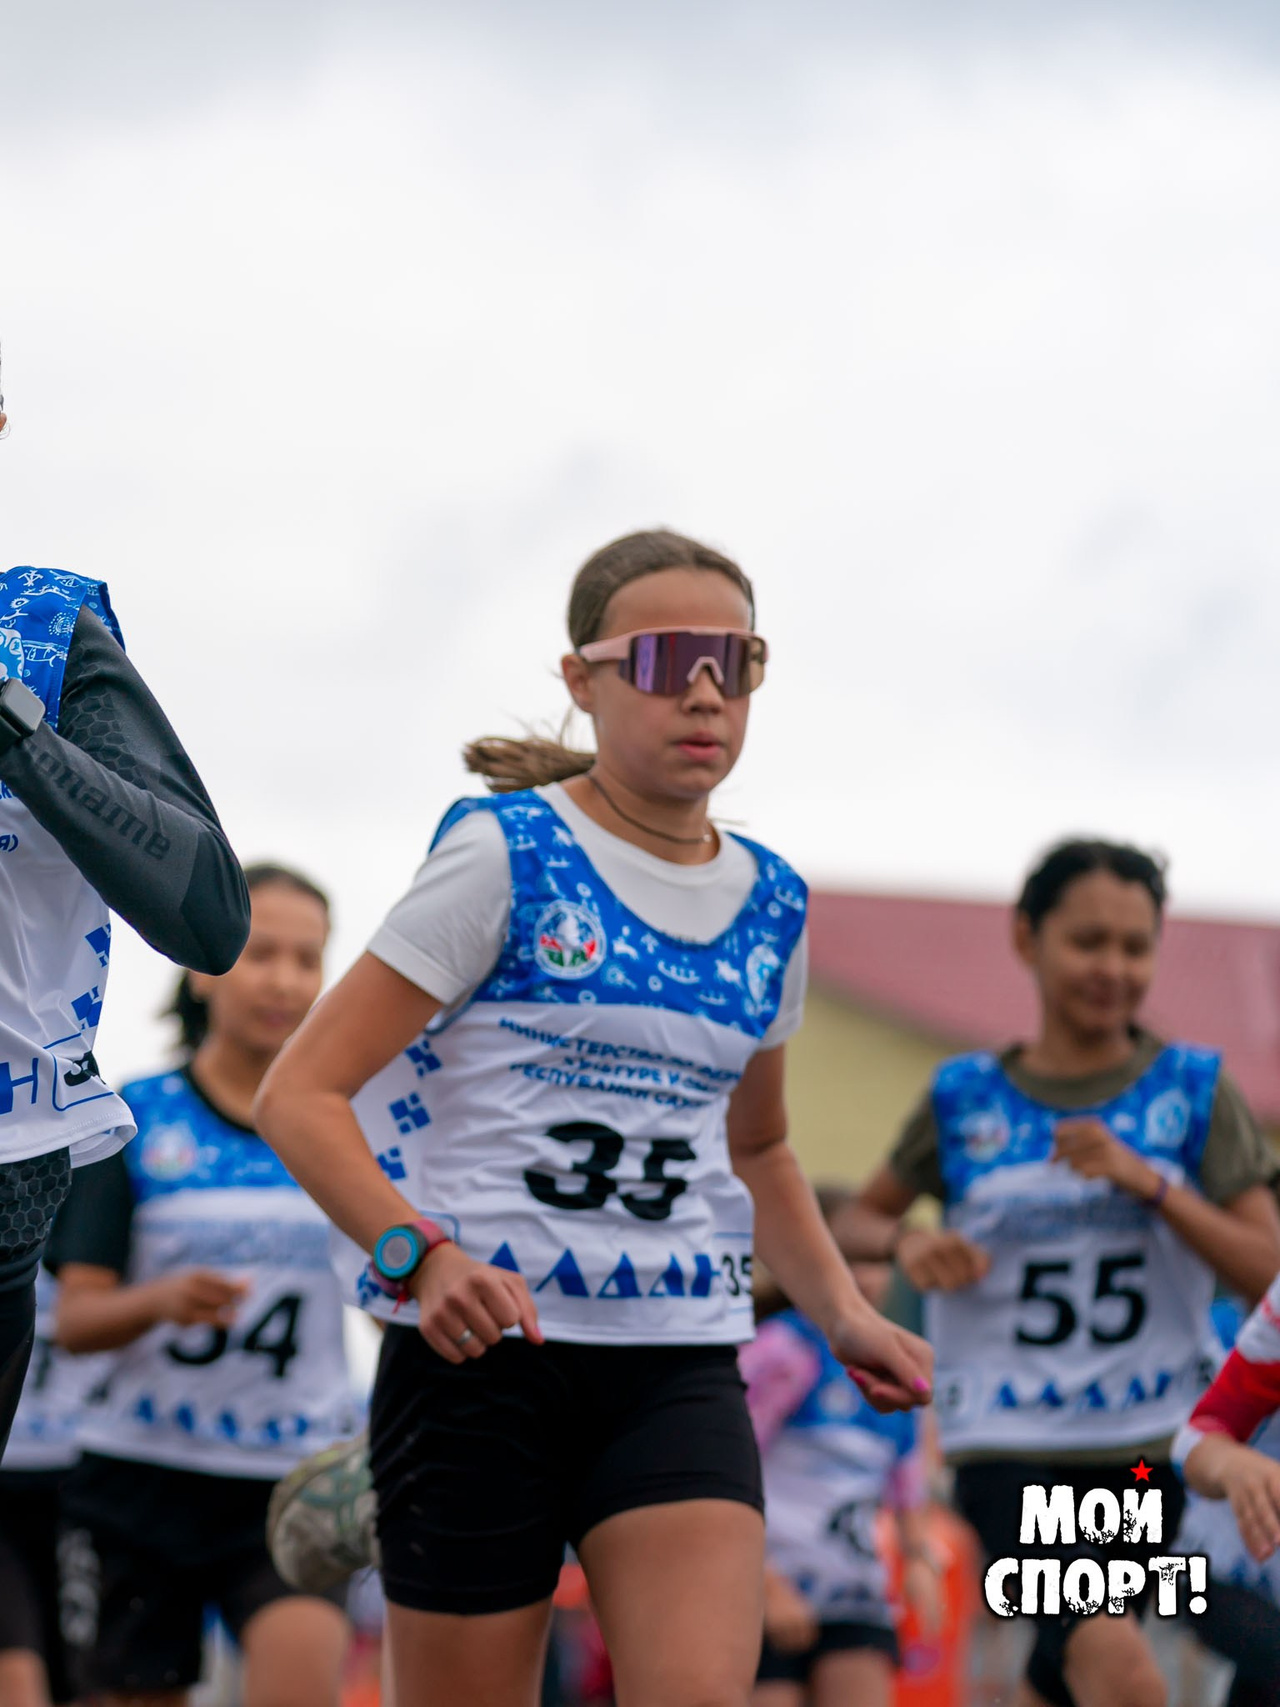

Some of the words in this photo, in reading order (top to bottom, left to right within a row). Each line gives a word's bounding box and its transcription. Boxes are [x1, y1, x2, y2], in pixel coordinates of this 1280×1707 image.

[23, 739, 171, 860] oname
[525, 1121, 697, 1221] 35
[1013, 1254, 1148, 1347] 55
